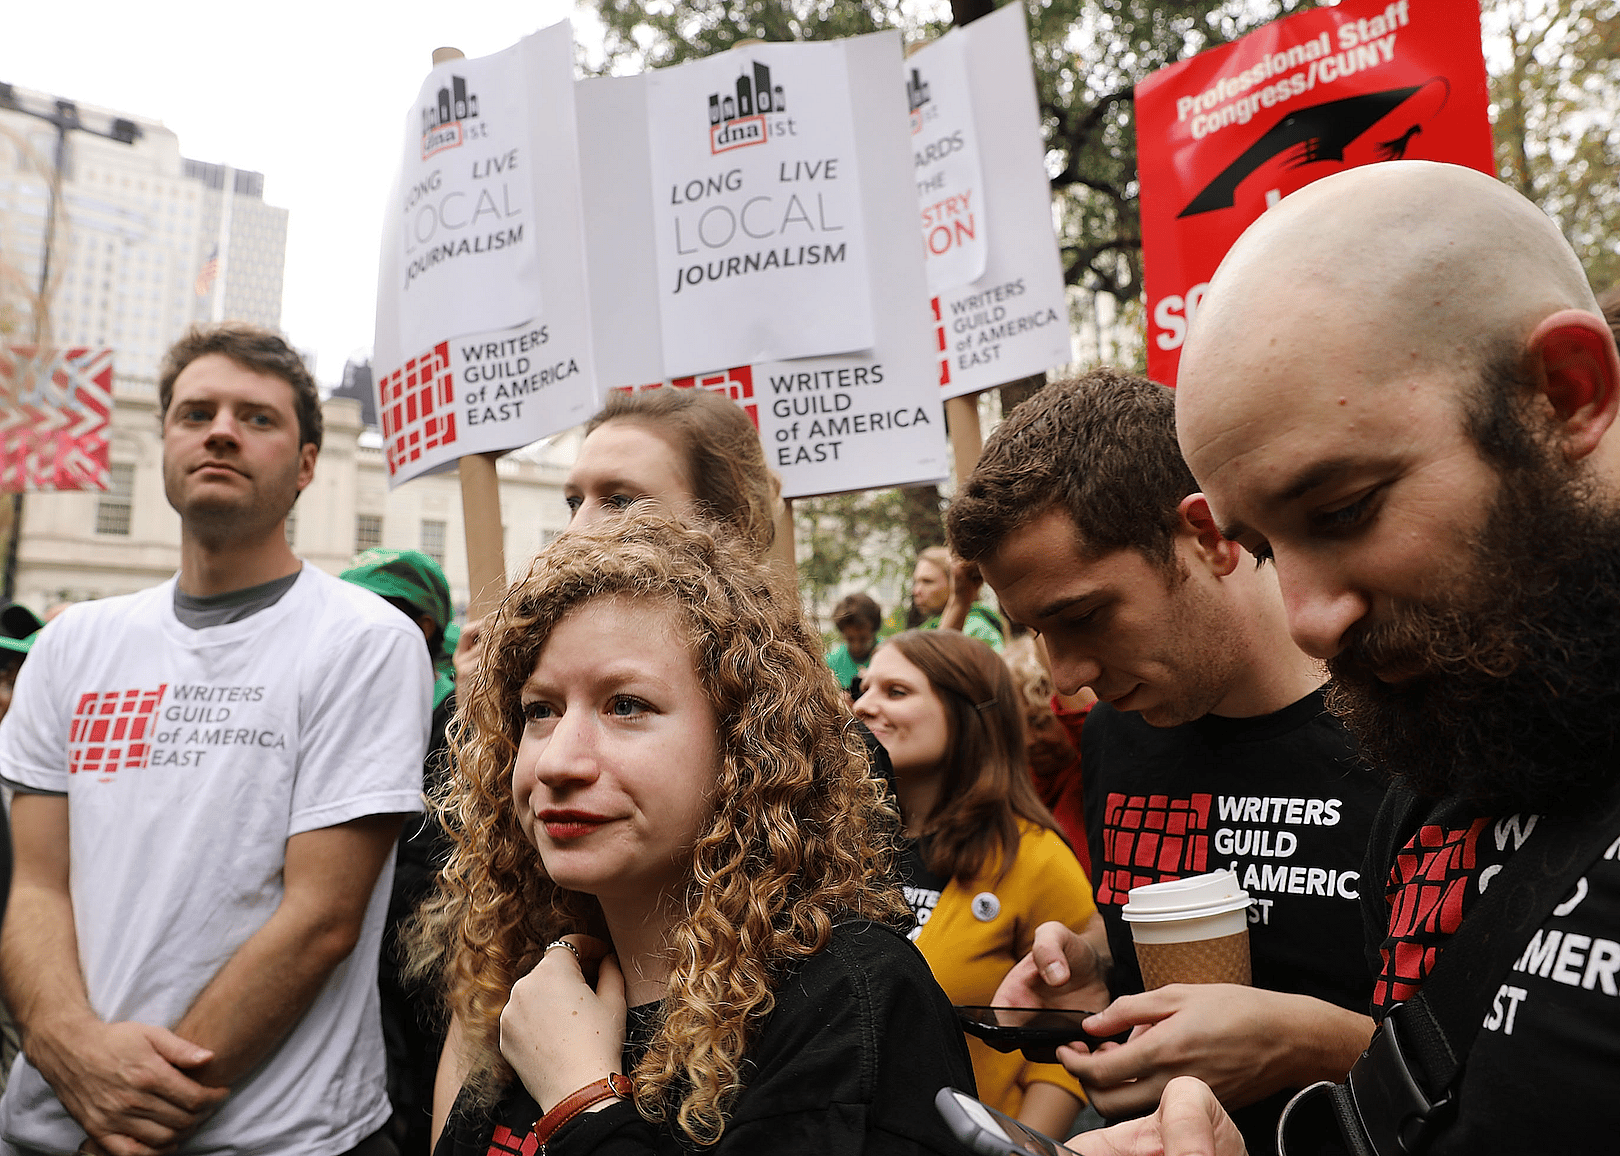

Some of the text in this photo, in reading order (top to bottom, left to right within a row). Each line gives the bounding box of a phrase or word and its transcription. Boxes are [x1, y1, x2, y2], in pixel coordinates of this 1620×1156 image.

[1177, 2, 1410, 122] Professional Staff
[1191, 34, 1398, 139] Congress/CUNY
[718, 123, 759, 145] dna
[914, 129, 964, 168] ARDS
[472, 148, 519, 180] LIVE
[671, 159, 838, 205] LONG LIVE
[675, 192, 844, 255] LOCAL
[921, 189, 972, 229] STRY
[403, 224, 524, 291] JOURNALISM
[672, 243, 847, 294] JOURNALISM
[951, 278, 1026, 315] WRITERS
[953, 306, 1006, 334] GUILD
[956, 308, 1058, 352] of AMERICA
[462, 325, 549, 362] WRITERS
[958, 345, 1000, 370] EAST
[464, 357, 530, 383] GUILD
[466, 359, 580, 405] of AMERICA
[770, 365, 884, 394] WRITERS
[467, 401, 524, 426] EAST
[773, 393, 852, 418] GUILD
[775, 407, 930, 442] of AMERICA
[778, 441, 842, 466] EAST
[173, 684, 265, 702] WRITERS
[165, 706, 230, 723] GUILD
[157, 728, 286, 750] of AMERICA
[151, 750, 206, 767] EAST
[1218, 795, 1343, 826] WRITERS
[1214, 828, 1298, 858] GUILD
[1242, 863, 1361, 900] AMERIC
[1248, 897, 1274, 926] ST
[1512, 928, 1620, 997] MER
[1483, 974, 1528, 1036] ST
